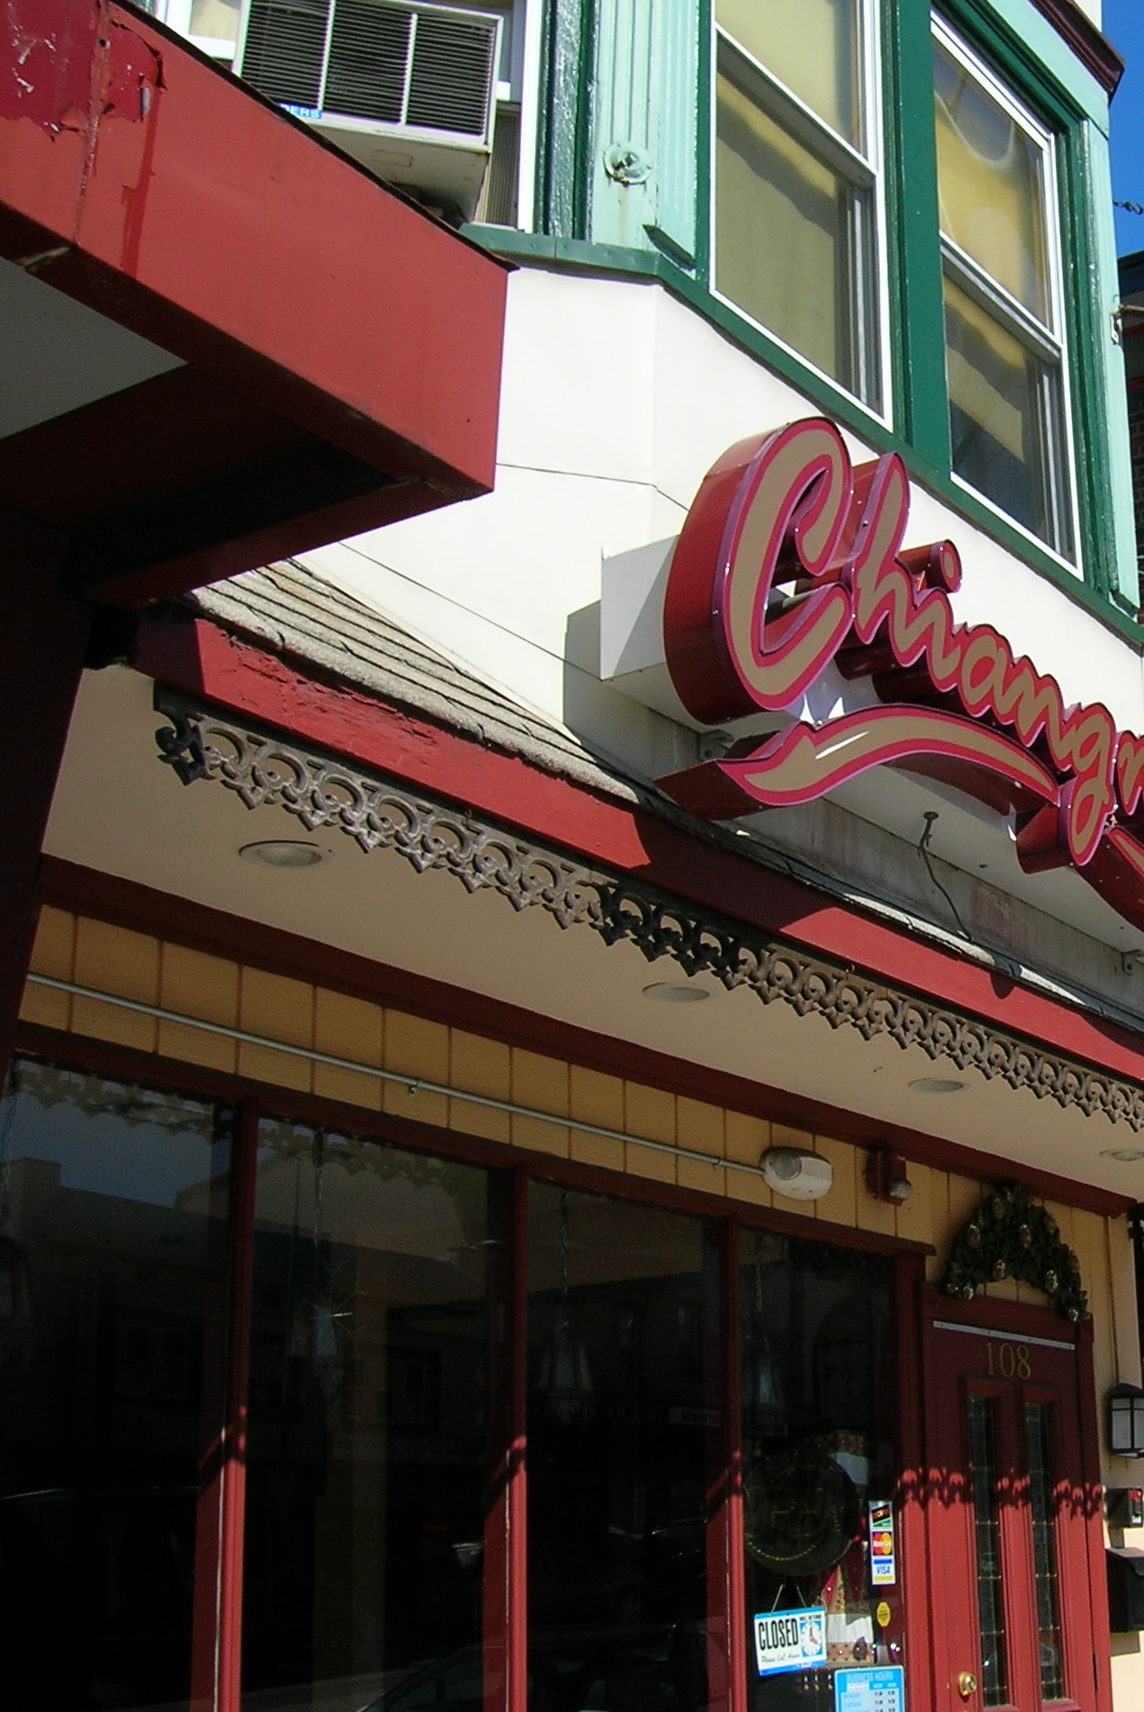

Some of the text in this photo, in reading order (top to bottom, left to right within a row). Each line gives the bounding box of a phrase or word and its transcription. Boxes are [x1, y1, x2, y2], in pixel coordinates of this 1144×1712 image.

[985, 1342, 1031, 1379] 108
[876, 1565, 891, 1574] VISA
[758, 1618, 799, 1651] CLOSED
